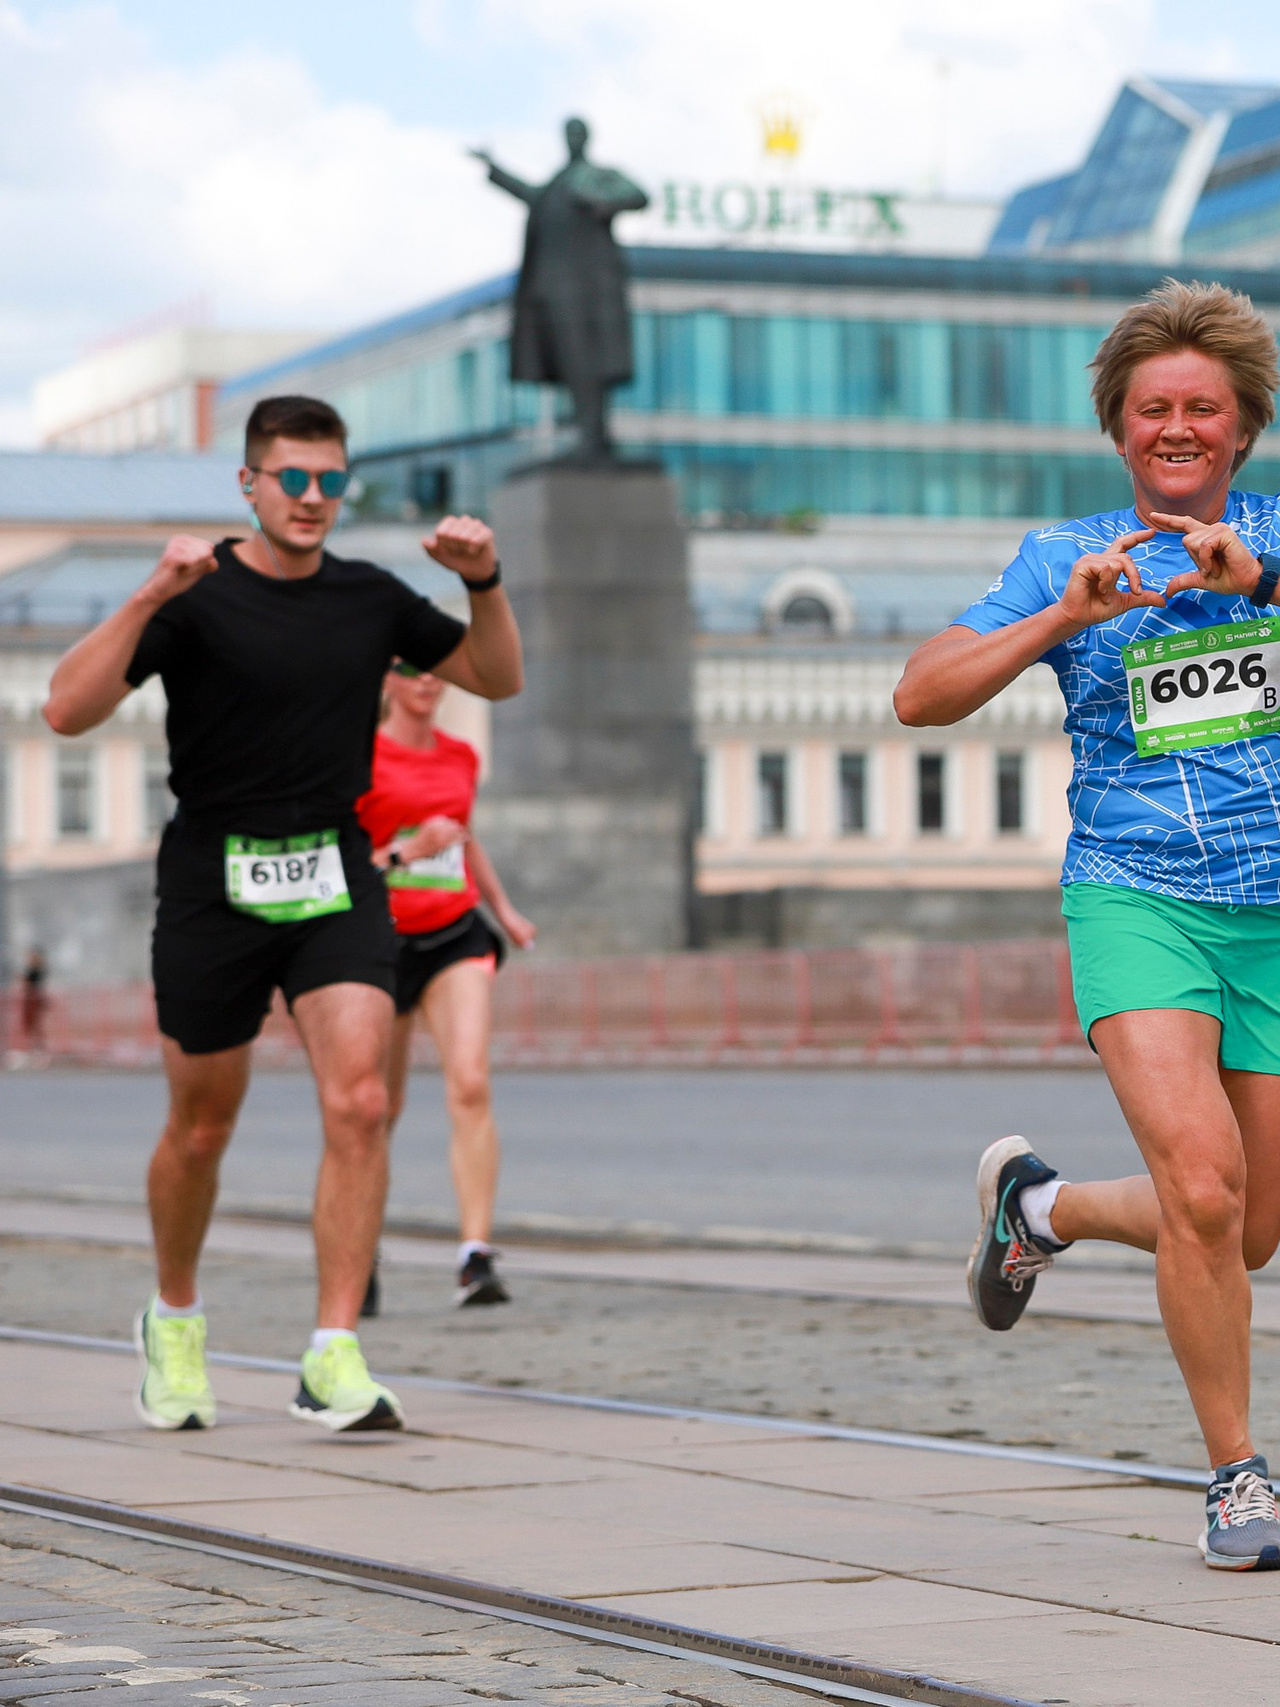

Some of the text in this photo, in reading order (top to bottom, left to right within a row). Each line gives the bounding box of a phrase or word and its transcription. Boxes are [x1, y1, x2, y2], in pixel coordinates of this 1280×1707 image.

[1150, 653, 1267, 704] 6026
[1135, 703, 1145, 715] 10
[1263, 687, 1277, 709] B
[250, 855, 319, 885] 6187
